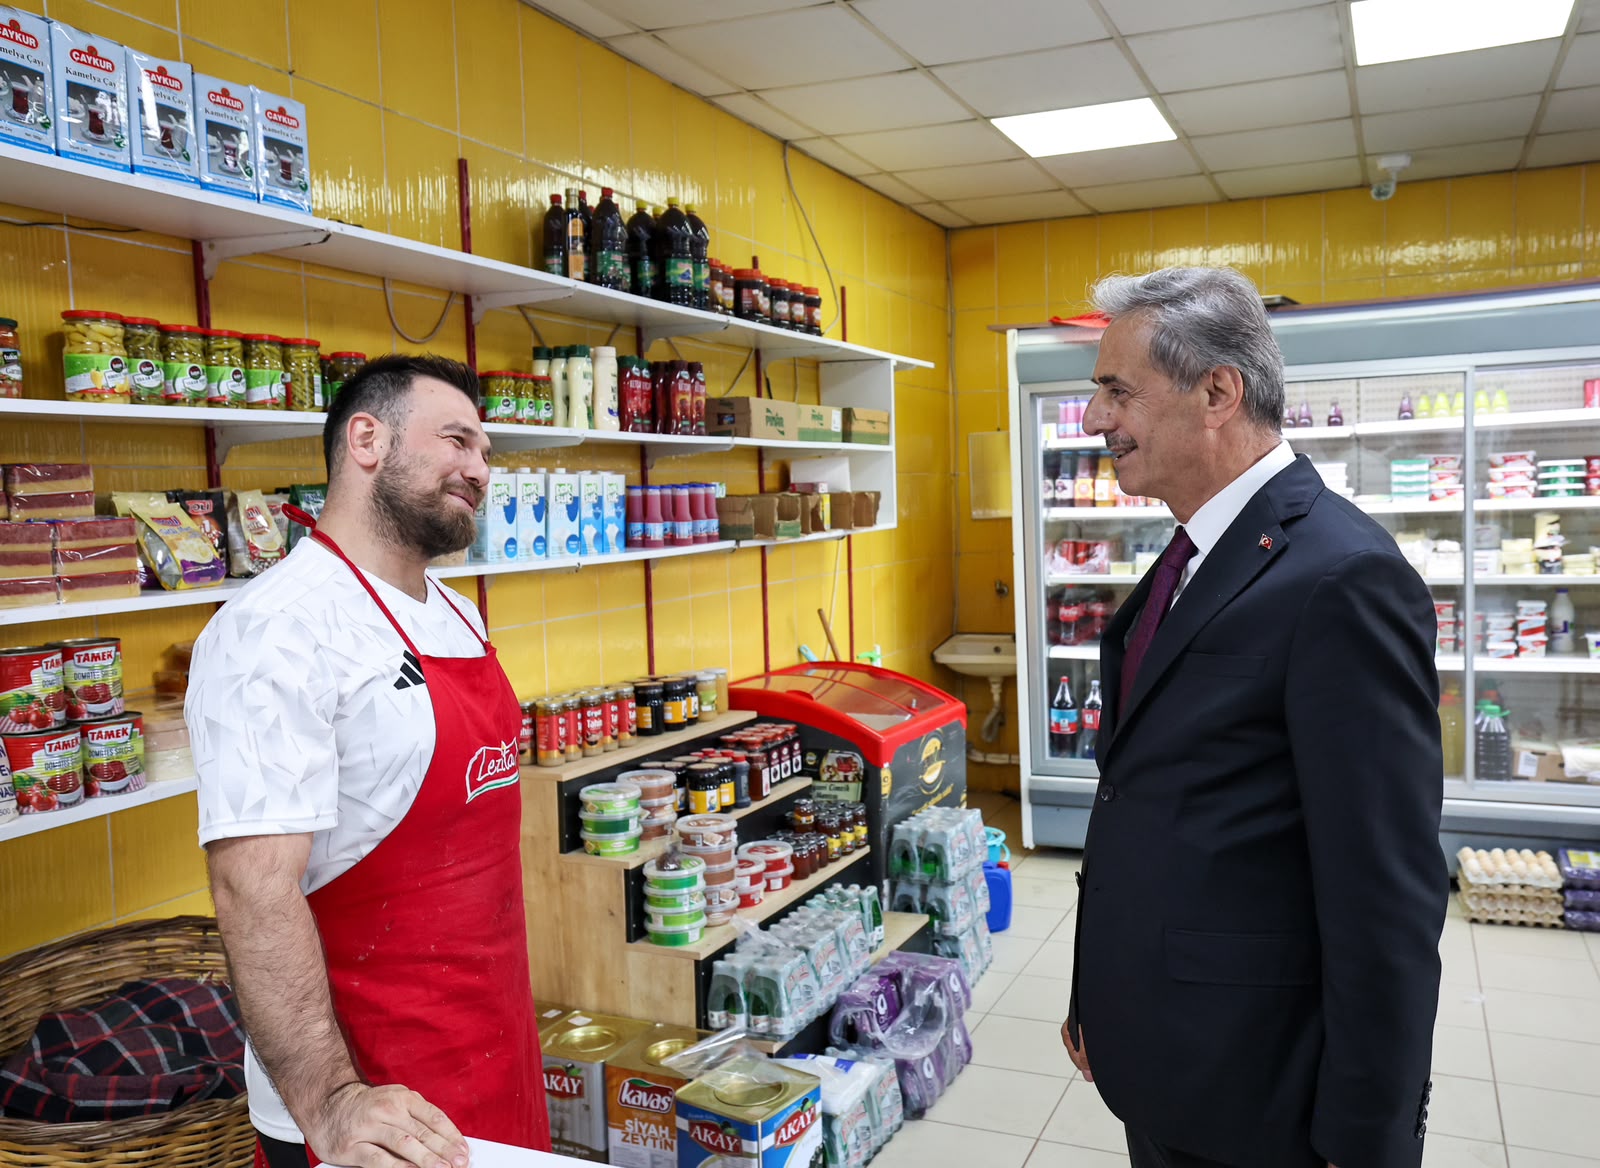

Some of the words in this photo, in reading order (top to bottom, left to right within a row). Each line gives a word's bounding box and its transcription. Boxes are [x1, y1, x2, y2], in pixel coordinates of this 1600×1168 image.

[0, 46, 25, 60] melya
[71, 51, 113, 71] ÇAYKUR
[65, 66, 101, 83] Kamelya
[103, 77, 118, 88] Çay
[208, 93, 244, 111] ÇAYKUR
[204, 106, 233, 121] Kamelya
[266, 110, 299, 127] ÇAYKUR
[44, 658, 62, 670] TAM
[75, 650, 113, 664] TAMEK
[89, 727, 129, 740] TAMEK
[476, 741, 516, 781] Lezita
[624, 1118, 669, 1138] SİYAH
[775, 1107, 814, 1146] AKAY
[690, 1125, 738, 1152] AKAY
